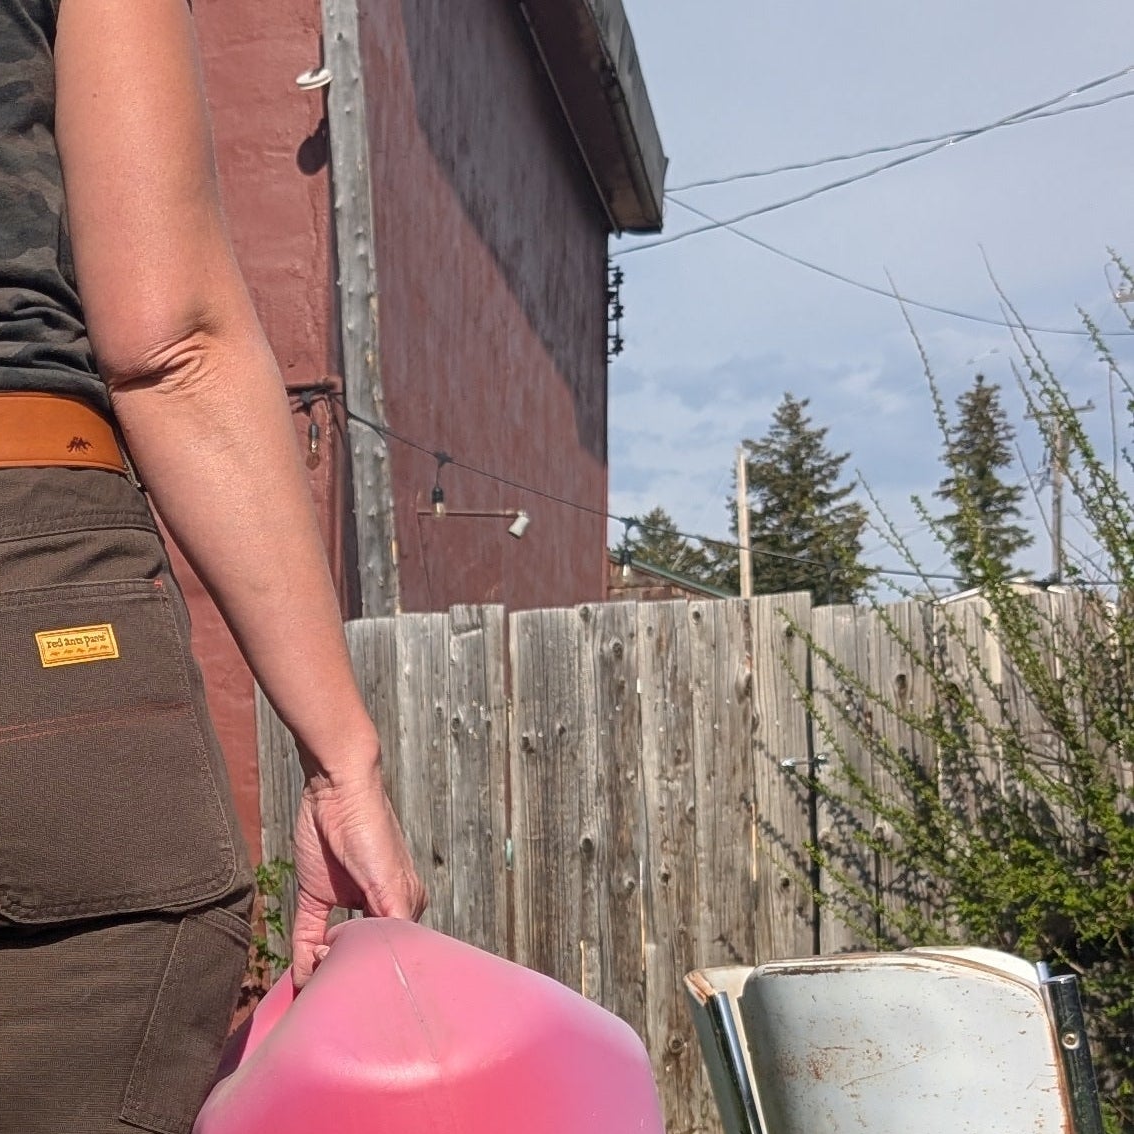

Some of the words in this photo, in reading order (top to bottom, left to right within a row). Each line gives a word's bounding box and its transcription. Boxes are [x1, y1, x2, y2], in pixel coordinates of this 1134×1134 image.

[46, 638, 63, 649] red
[64, 636, 83, 646] ants
[84, 634, 106, 647] pants
